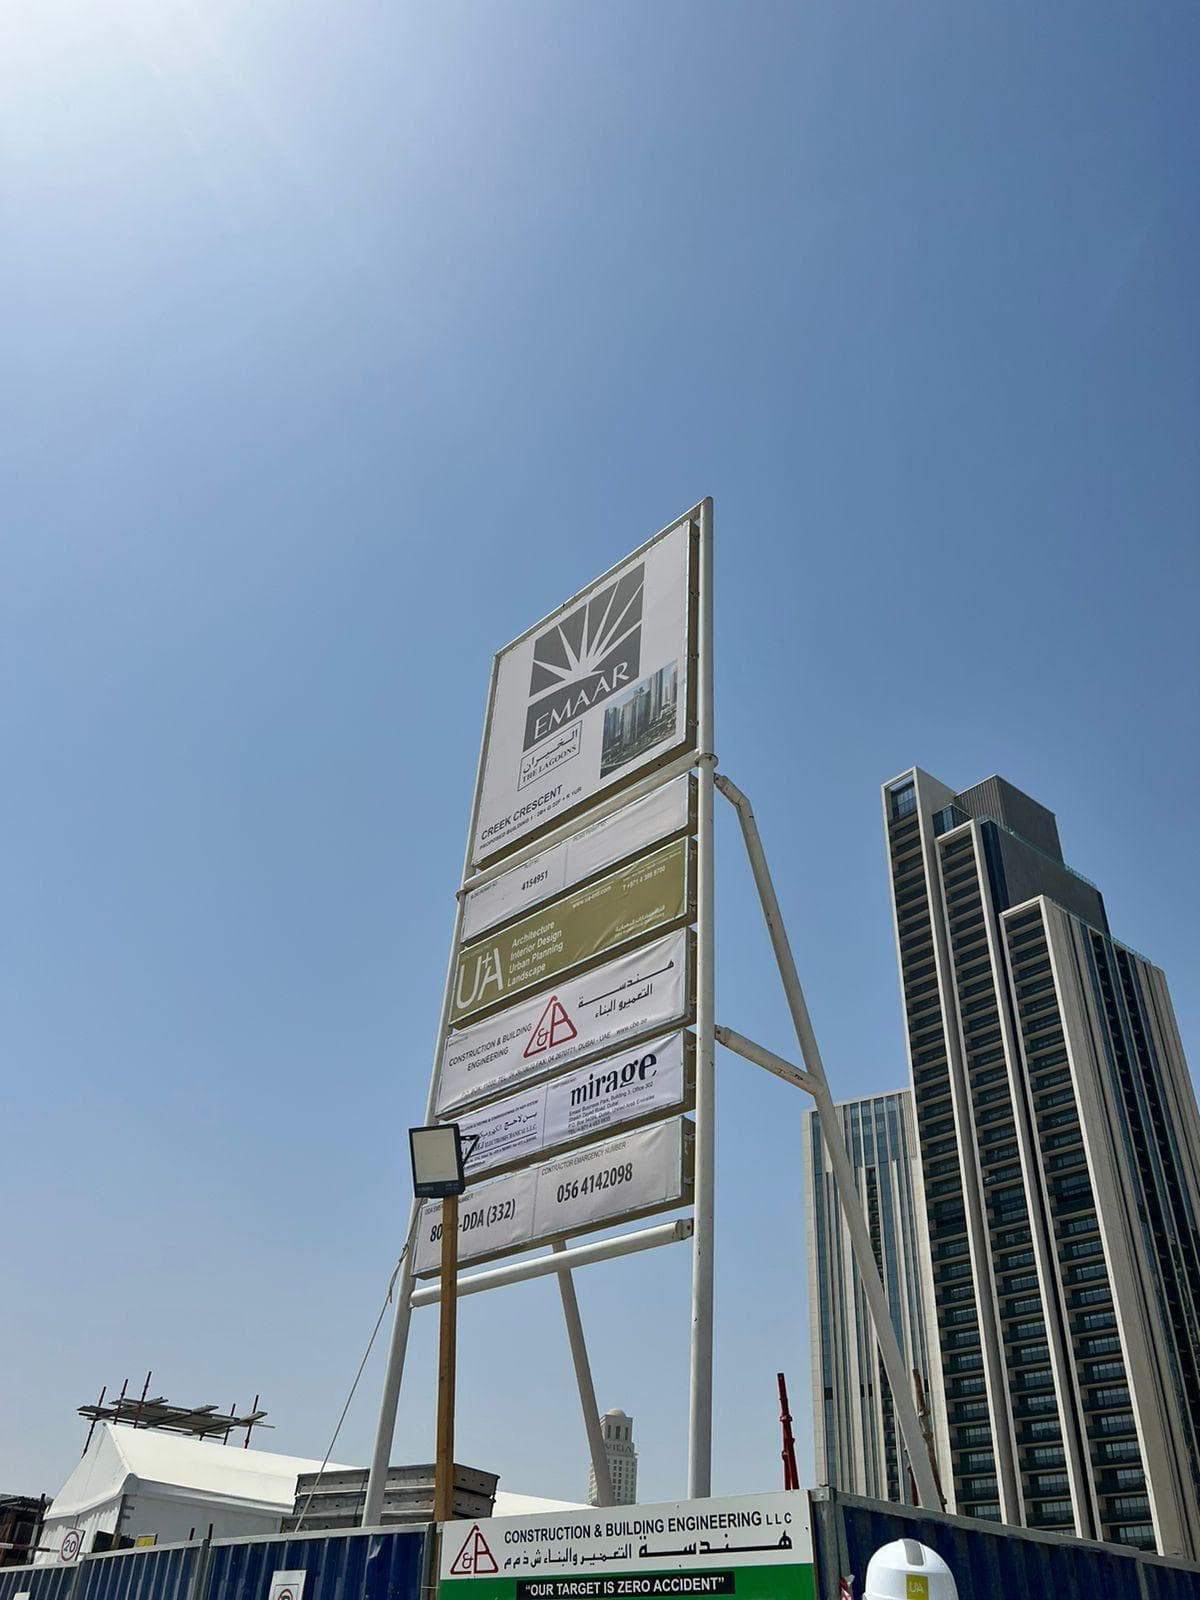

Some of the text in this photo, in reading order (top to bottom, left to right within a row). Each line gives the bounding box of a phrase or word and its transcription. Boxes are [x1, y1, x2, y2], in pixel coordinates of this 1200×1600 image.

[534, 661, 630, 740] EMAAR
[523, 744, 577, 783] THE LAGOONS
[481, 784, 563, 840] CREEK CRESCENT
[510, 942, 535, 961] Interior
[536, 929, 562, 948] Design
[512, 921, 555, 948] Architecture
[509, 942, 564, 974] Urban Planning
[507, 963, 546, 987] Landscape
[448, 1038, 496, 1067] CONSTRUCTION
[496, 1037, 501, 1046] &
[502, 1022, 533, 1043] BUILDING
[467, 1046, 509, 1071] ENGINEERING
[570, 1053, 657, 1106] mirage
[541, 1159, 574, 1176] CONTRACTOR
[557, 1162, 633, 1203] 056 4142098
[487, 1198, 516, 1228] (332)
[504, 1525, 591, 1544] CONSTRUCTION
[594, 1523, 602, 1538] &
[606, 1518, 664, 1536] BUILDING
[668, 1510, 762, 1532] ENGINEERING
[63, 1540, 77, 1553] 20
[639, 1530, 792, 1558] هندسة
[556, 1582, 601, 1596] TARGET
[604, 1582, 615, 1593] IS
[617, 1579, 650, 1594] ZERO
